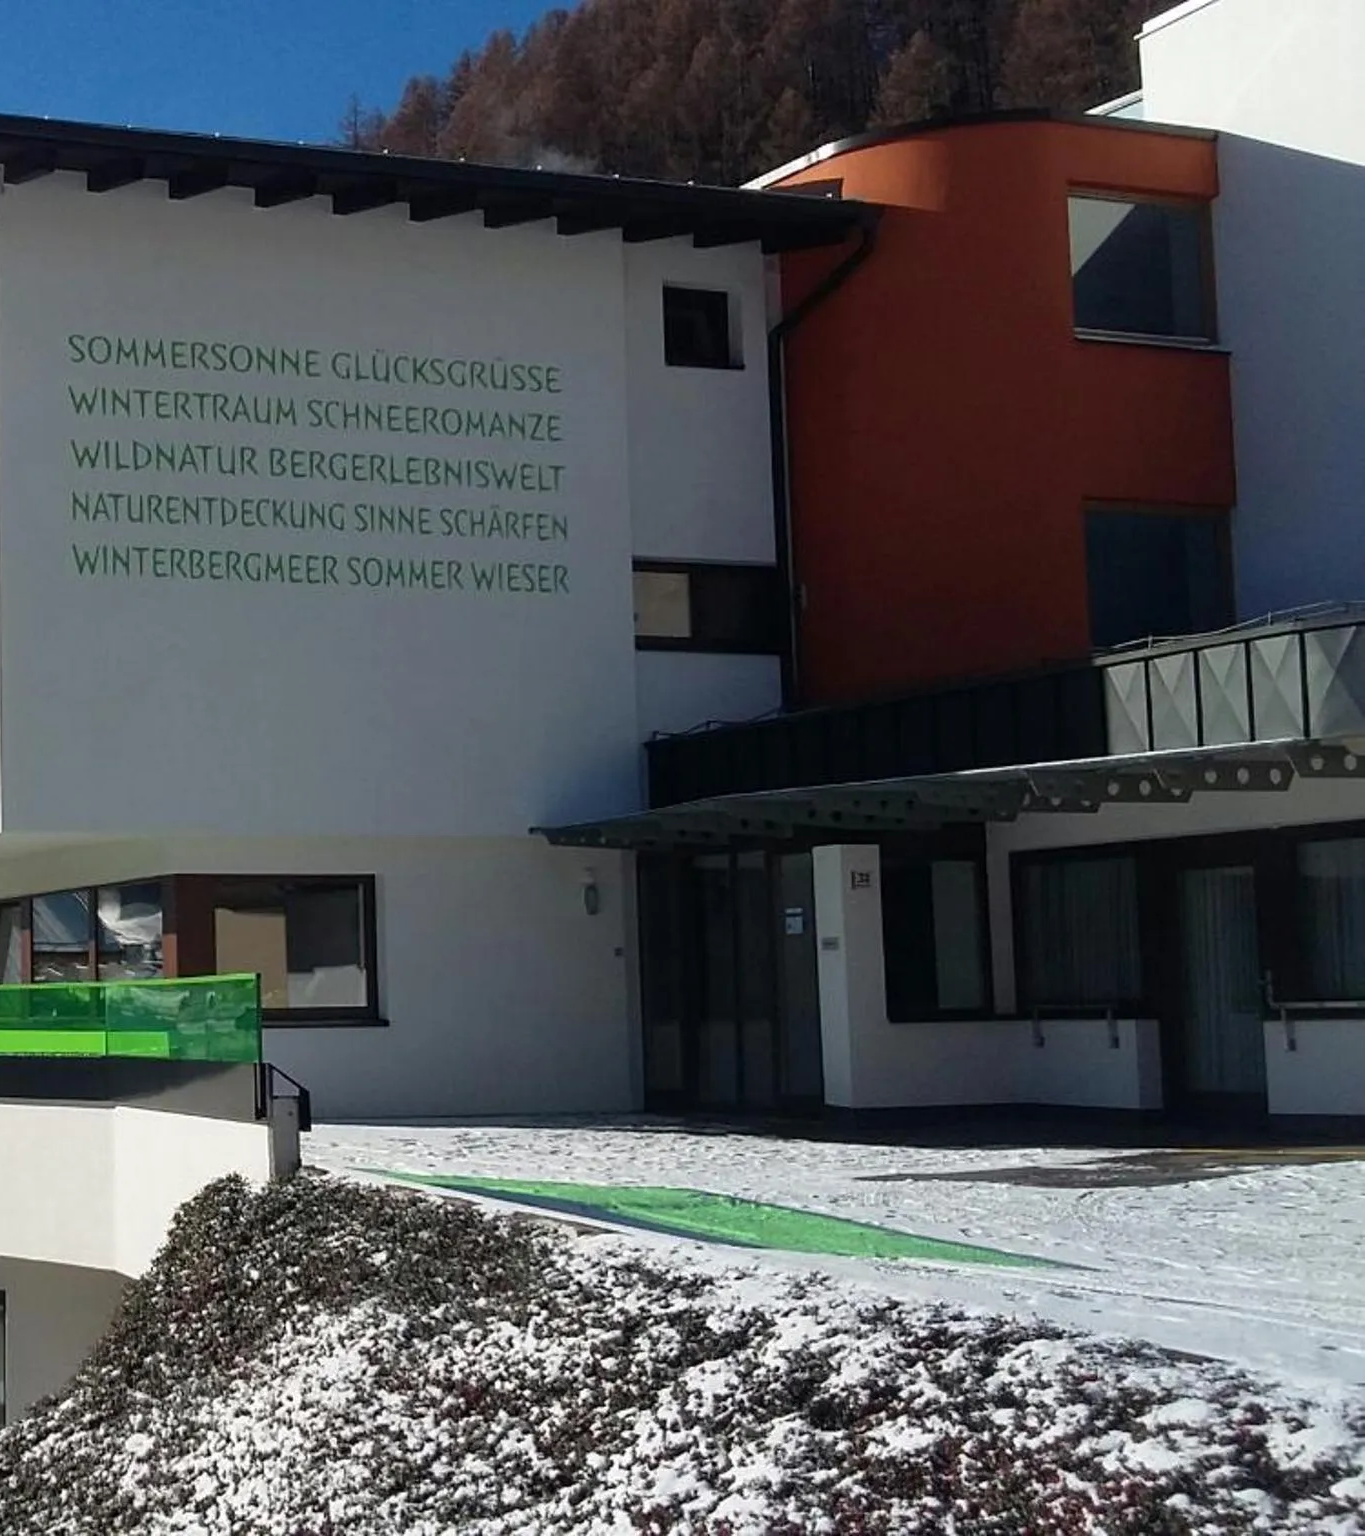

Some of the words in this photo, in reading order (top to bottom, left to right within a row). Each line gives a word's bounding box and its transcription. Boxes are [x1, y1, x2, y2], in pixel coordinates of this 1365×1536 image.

[68, 334, 321, 377] SOMMERSONNE
[331, 348, 562, 393] GLÜCKSGRÜSSE
[68, 385, 297, 426] WINTERTRAUM
[307, 399, 563, 442] SCHNEEROMANZE
[71, 439, 259, 476] WILDNATUR
[269, 448, 566, 491] BERGERLEBNISWELT
[72, 491, 345, 531] NATURENTDECKUNG
[354, 504, 433, 535] SINNE
[439, 505, 568, 541] SCHÄRFEN
[72, 543, 339, 584] WINTERBERGMEER
[347, 556, 464, 589] SOMMER
[471, 562, 569, 594] WIESER
